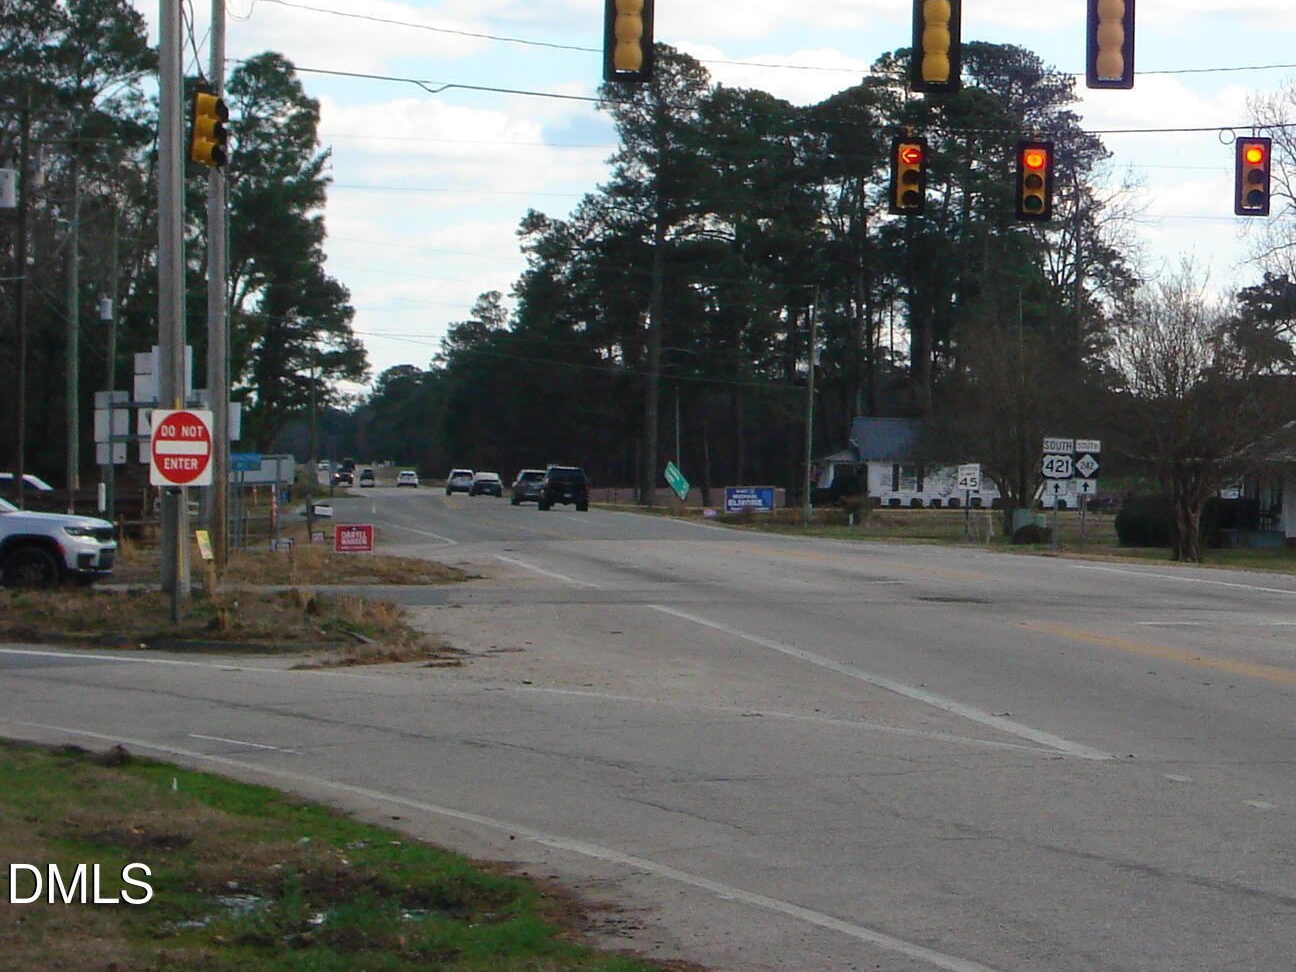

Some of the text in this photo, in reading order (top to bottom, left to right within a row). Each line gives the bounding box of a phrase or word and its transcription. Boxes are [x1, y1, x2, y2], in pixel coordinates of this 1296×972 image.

[161, 425, 204, 438] DO NOT
[1044, 440, 1072, 451] SOUTH
[163, 458, 198, 470] ENTER
[1045, 459, 1069, 473] 421
[959, 477, 978, 487] 45
